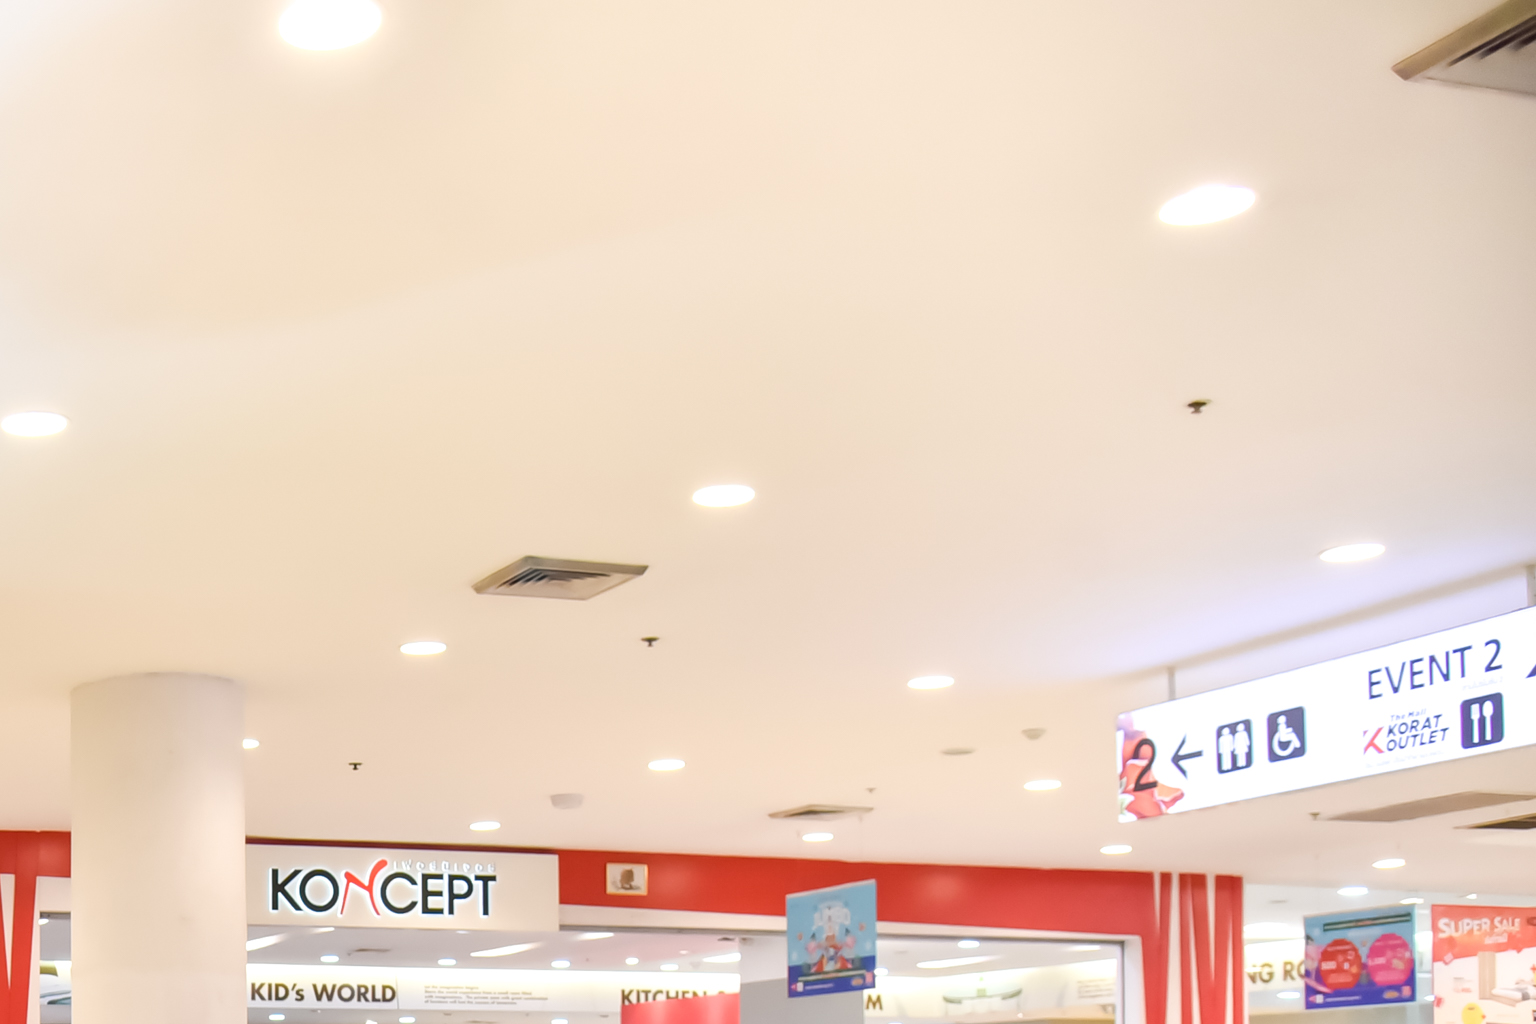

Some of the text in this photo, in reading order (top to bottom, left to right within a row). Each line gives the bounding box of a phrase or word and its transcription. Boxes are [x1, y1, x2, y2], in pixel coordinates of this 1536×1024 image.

[1368, 639, 1503, 700] EVENT 2
[1386, 714, 1443, 738] KORAT
[1390, 708, 1426, 722] The Mall
[1386, 727, 1450, 752] OUTLET
[1133, 738, 1158, 792] 2
[271, 859, 497, 916] KONCEPT
[1438, 917, 1491, 938] SUPER
[1493, 916, 1521, 932] SALE
[250, 982, 397, 1003] KID's WORLD
